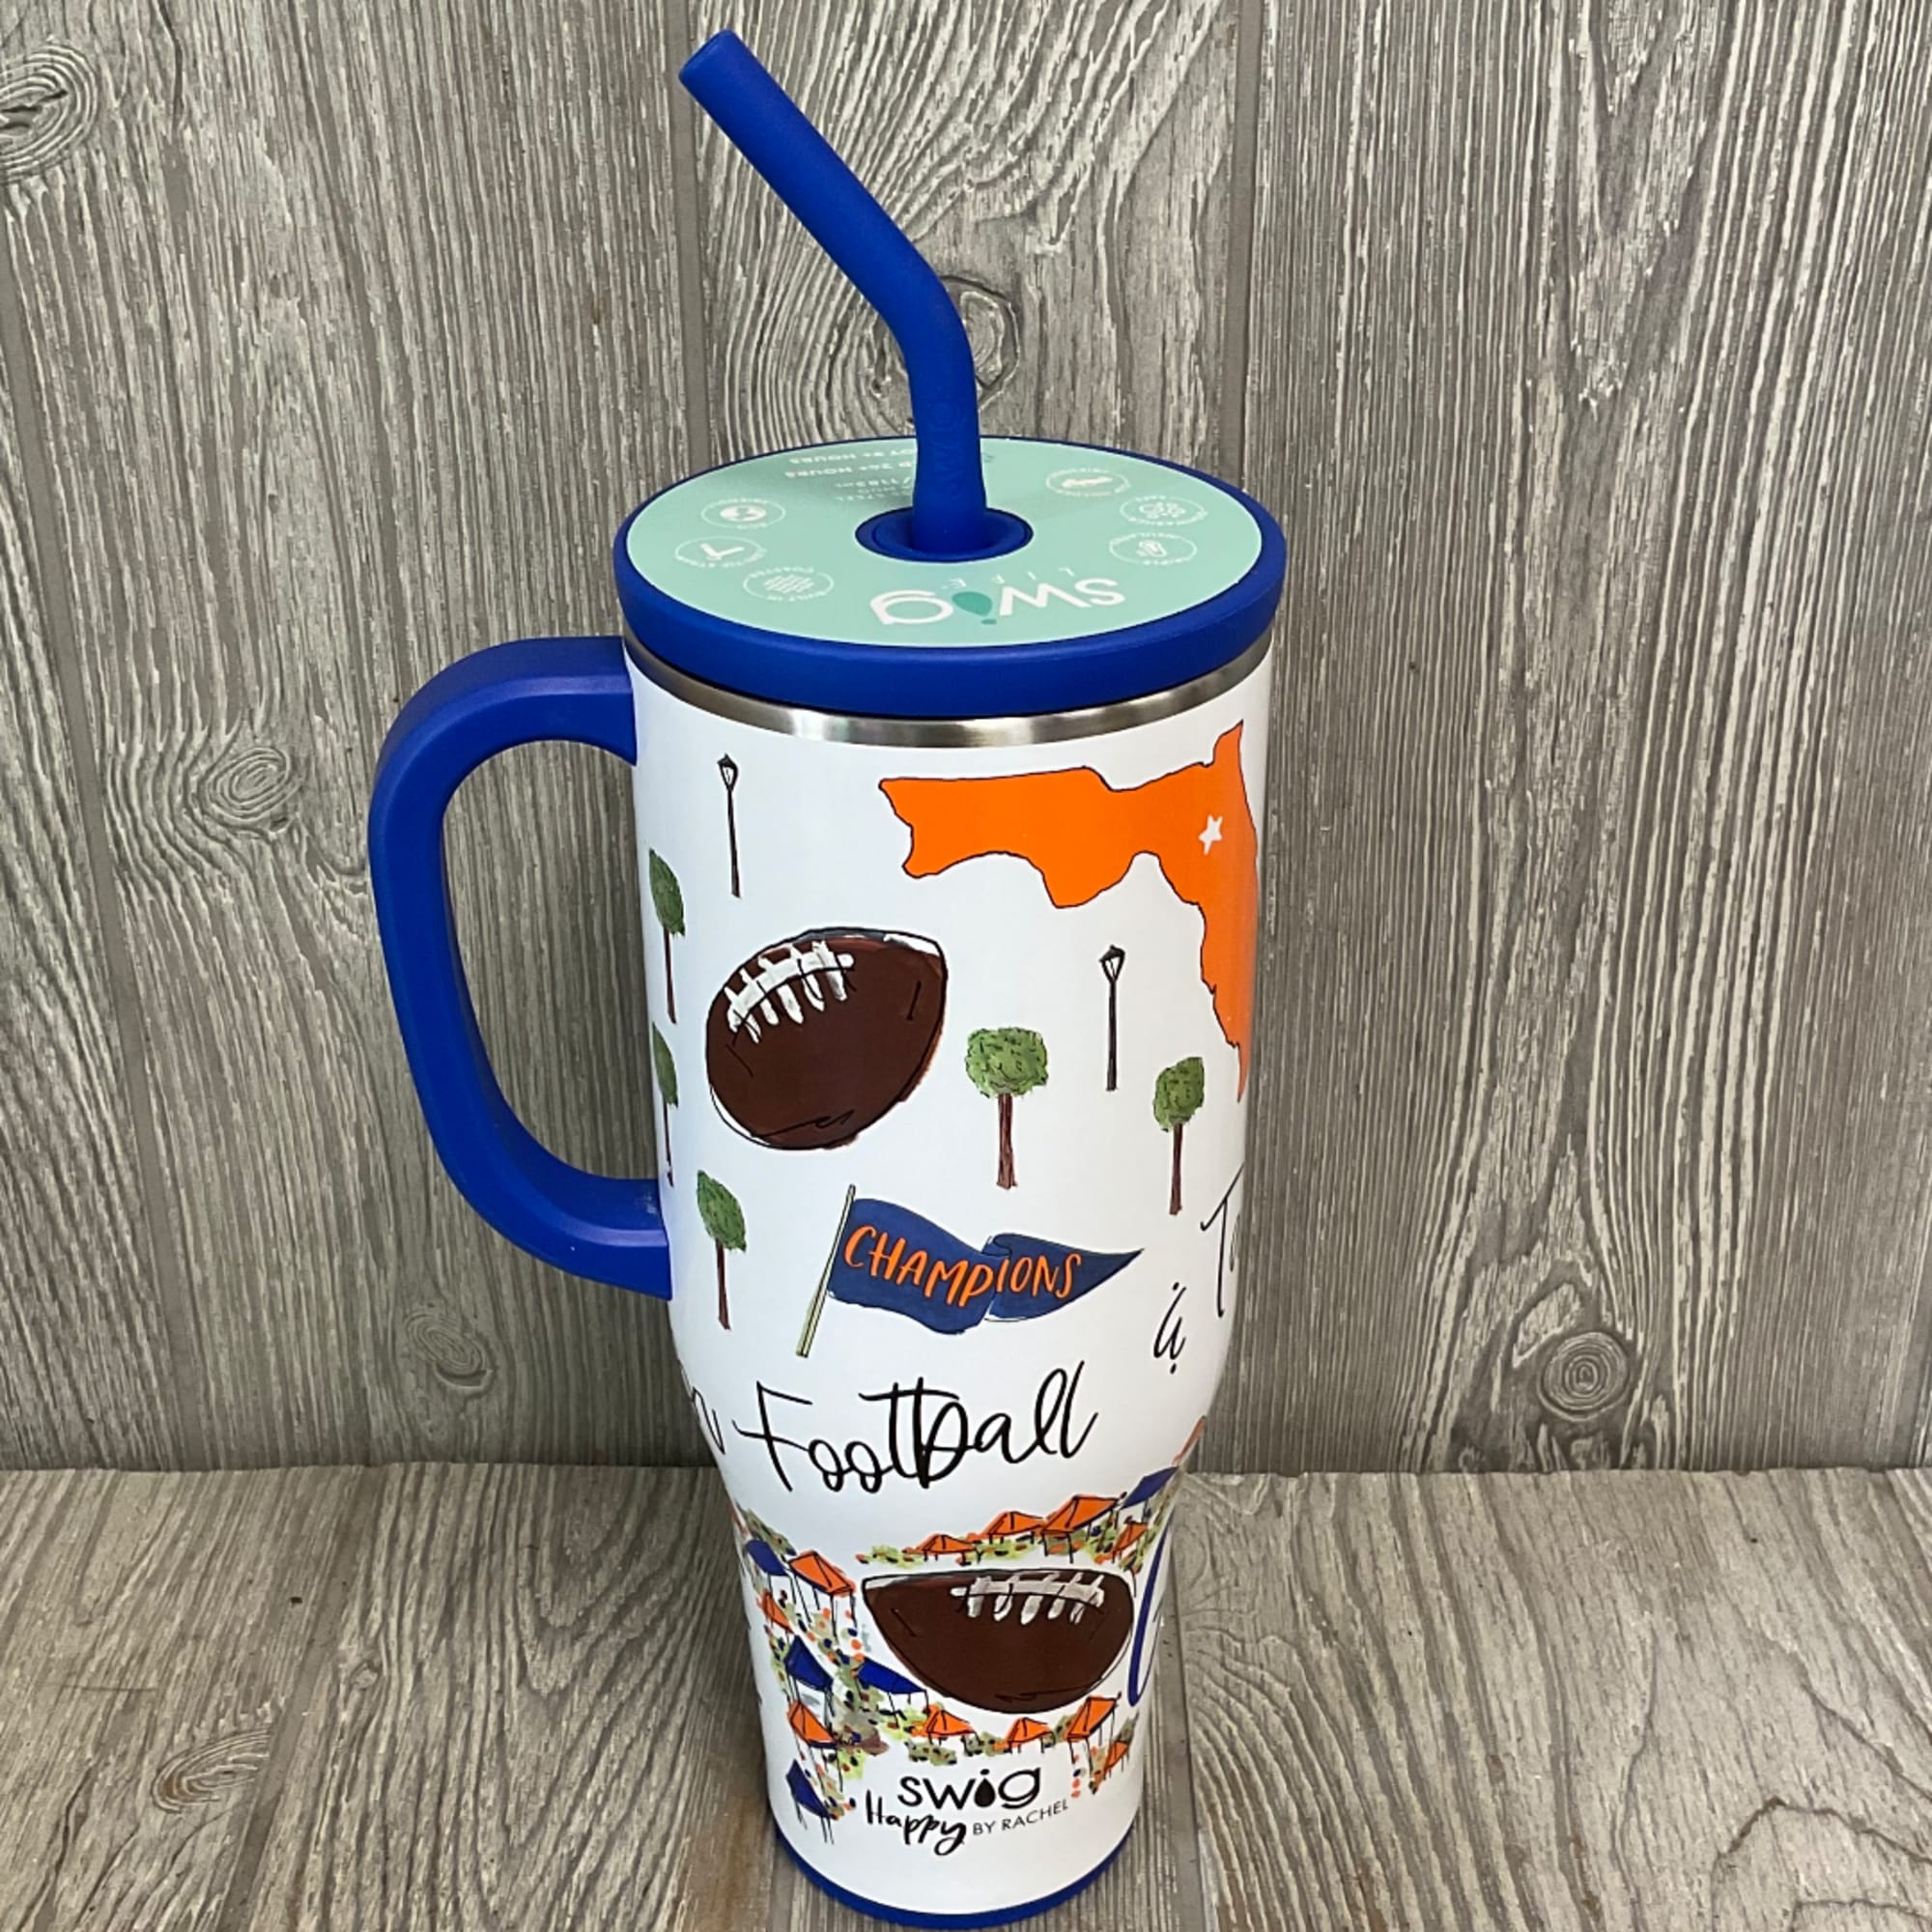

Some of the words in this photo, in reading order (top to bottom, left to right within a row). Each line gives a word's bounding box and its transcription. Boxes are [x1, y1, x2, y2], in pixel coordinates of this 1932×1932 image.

[784, 467, 853, 478] HOURS
[844, 1225, 1082, 1307] CHAMPIONS
[731, 1360, 1099, 1493] Football
[866, 1789, 967, 1856] Happy
[972, 1819, 996, 1835] BY
[1001, 1799, 1069, 1832] RACHEL
